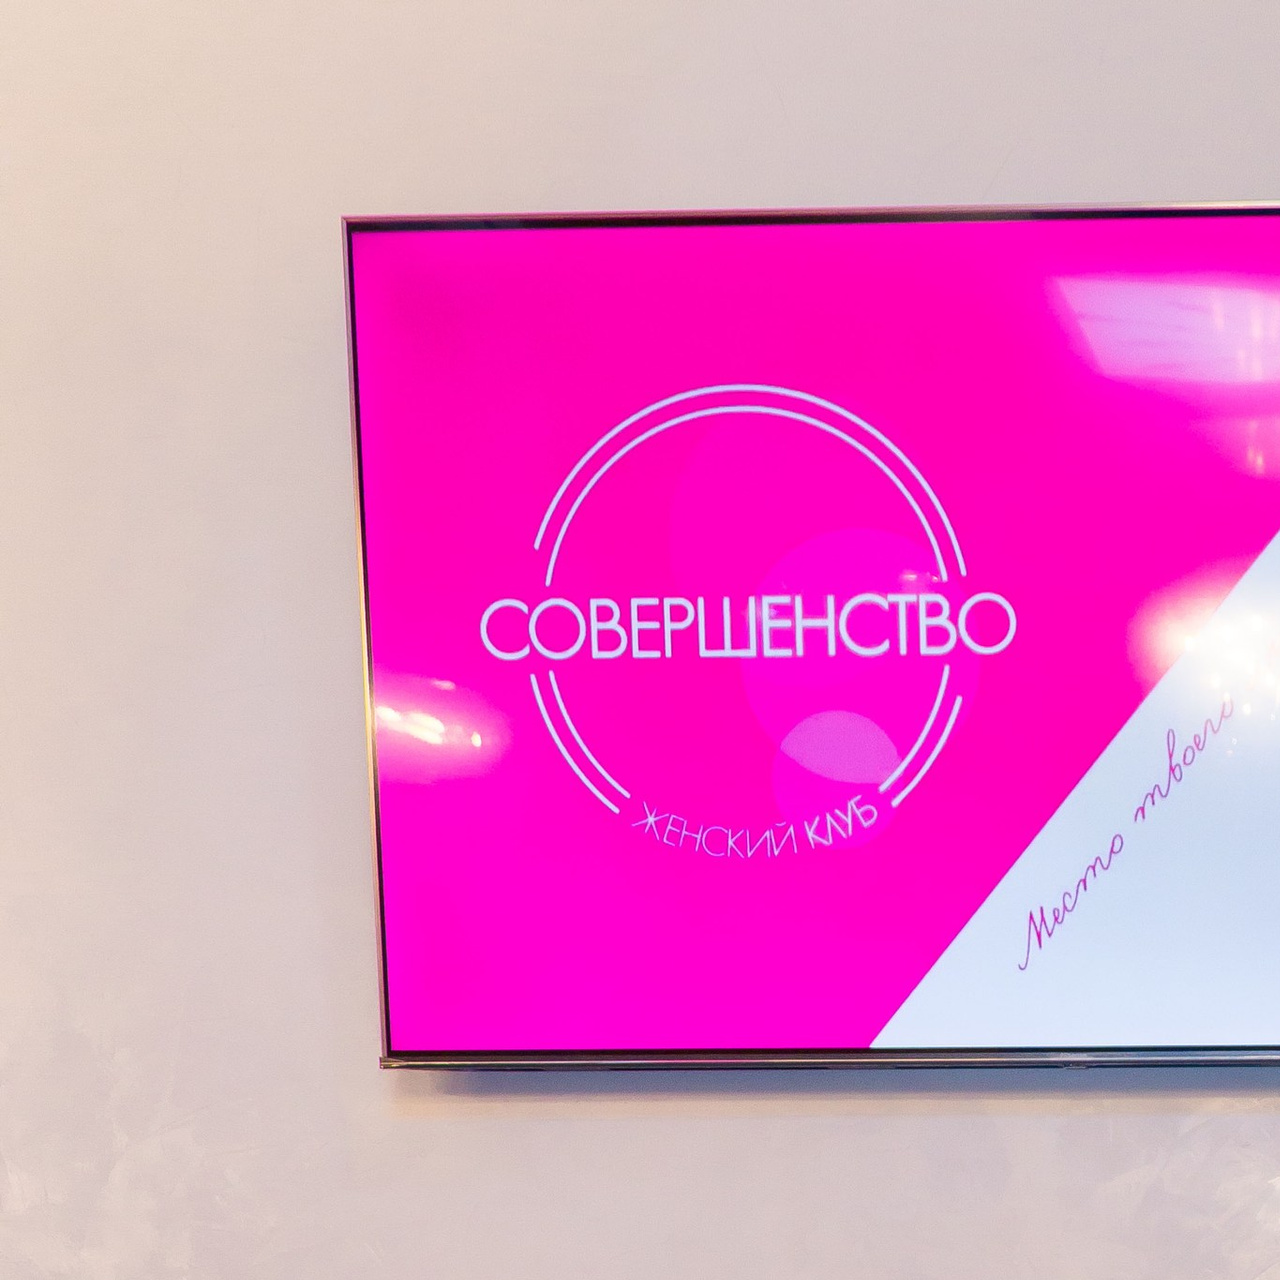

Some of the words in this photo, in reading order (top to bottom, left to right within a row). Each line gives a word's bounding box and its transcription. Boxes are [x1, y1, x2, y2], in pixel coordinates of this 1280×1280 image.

[480, 592, 1016, 661] СОВЕРШЕНСТВО
[631, 800, 798, 859] ЖЕНСКИЙ
[804, 794, 879, 850] КЛУБ
[1018, 834, 1124, 970] Место
[1134, 697, 1234, 822] твоего
